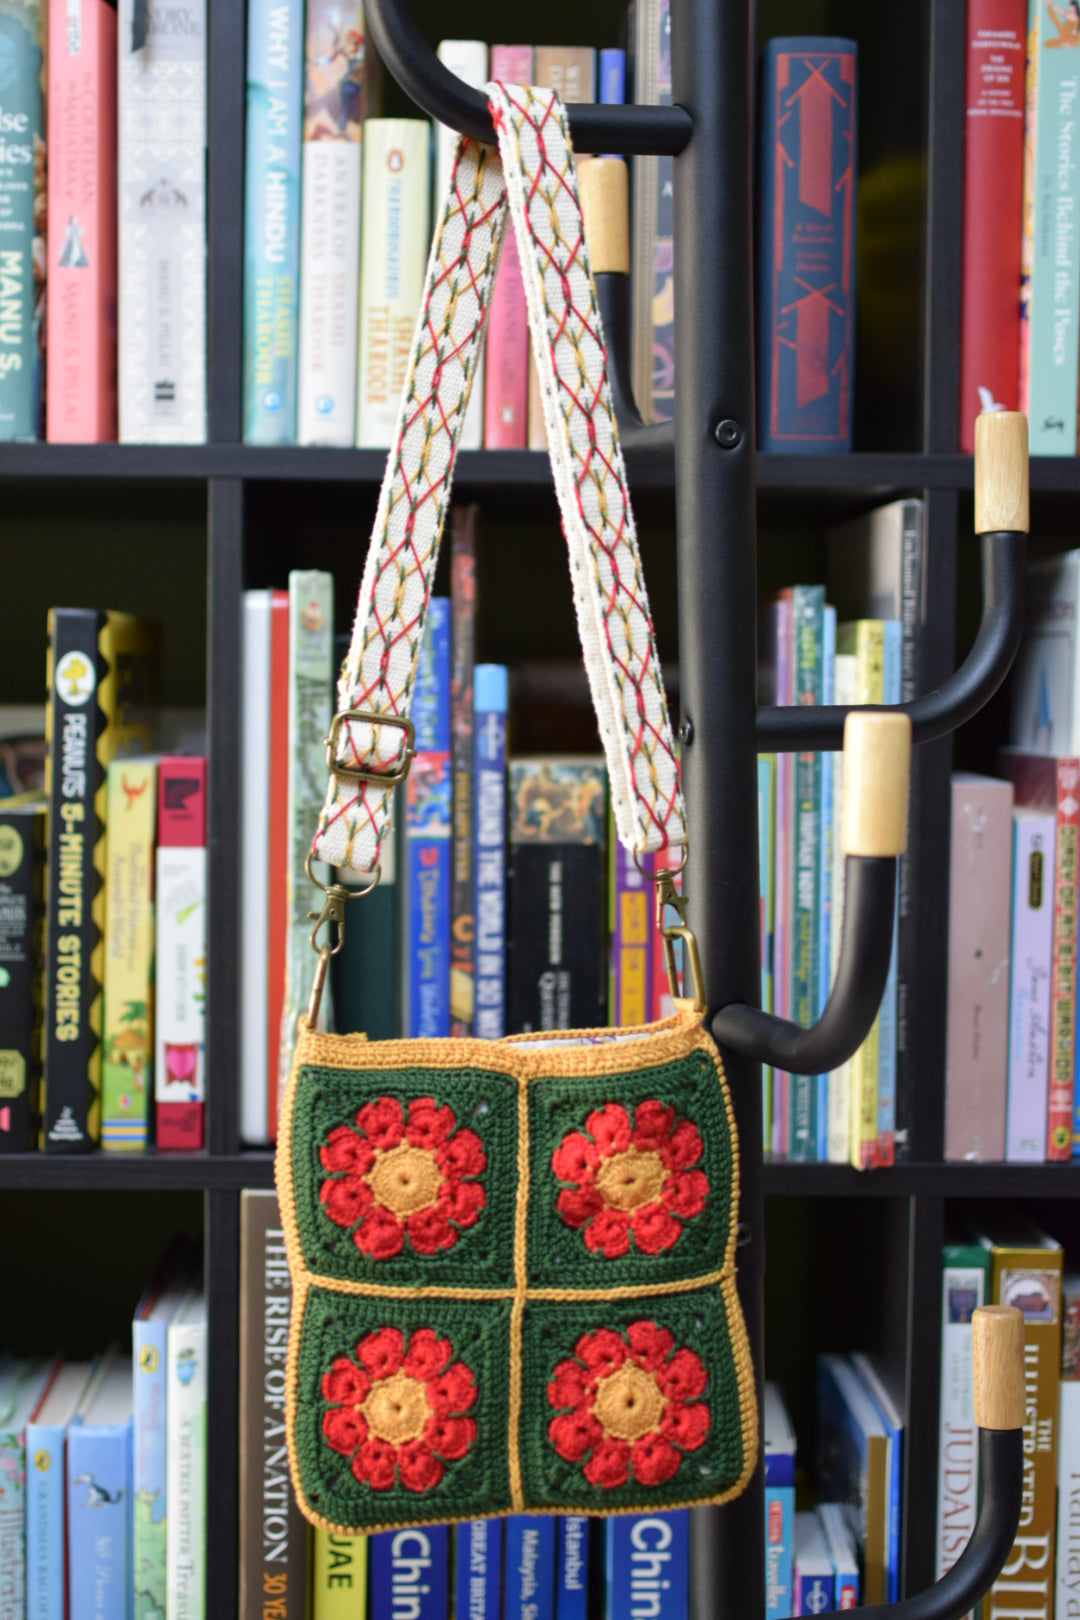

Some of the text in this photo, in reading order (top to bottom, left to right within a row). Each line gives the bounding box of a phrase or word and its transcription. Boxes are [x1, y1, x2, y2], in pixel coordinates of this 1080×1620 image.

[0, 105, 29, 133] se
[1058, 75, 1078, 115] The
[264, 6, 289, 263] WHY I AM A HINDU
[1057, 120, 1076, 191] Stories
[1055, 196, 1075, 266] Behind
[0, 250, 23, 345] MANU
[63, 280, 81, 343] MANU
[275, 275, 292, 356] SHASHI
[311, 272, 329, 373] THAROOR
[330, 272, 347, 347] SHASHI
[1054, 271, 1073, 304] the
[0, 352, 23, 378] S.
[255, 276, 275, 386] THAROOR
[367, 305, 392, 405] THAROOR
[391, 315, 415, 395] SHASHI
[63, 365, 80, 424] PILLAI
[477, 770, 504, 846] AROUND
[55, 713, 88, 1042] PEANUTS 5-MINUTE STORIES
[477, 850, 503, 888] THE
[477, 890, 503, 951] WORLD
[477, 954, 502, 977] IN
[1025, 957, 1050, 1080] Jane Austen
[264, 1227, 291, 1290] THE
[264, 1294, 292, 1366] RISE
[264, 1369, 288, 1411] OF
[263, 1416, 287, 1439] A
[1037, 1417, 1053, 1454] THE
[263, 1443, 289, 1563] NATION
[0, 1507, 25, 1620] Illustrate
[262, 1571, 288, 1595] 30
[391, 1529, 433, 1620] Chin
[519, 1529, 540, 1601] Malaysia,
[565, 1517, 587, 1590] Istanbul
[630, 1518, 673, 1620] Chin
[766, 1545, 786, 1609] traveller
[990, 1528, 1051, 1620] BI
[175, 1559, 197, 1620] Treasu
[469, 1577, 487, 1620] BRITA
